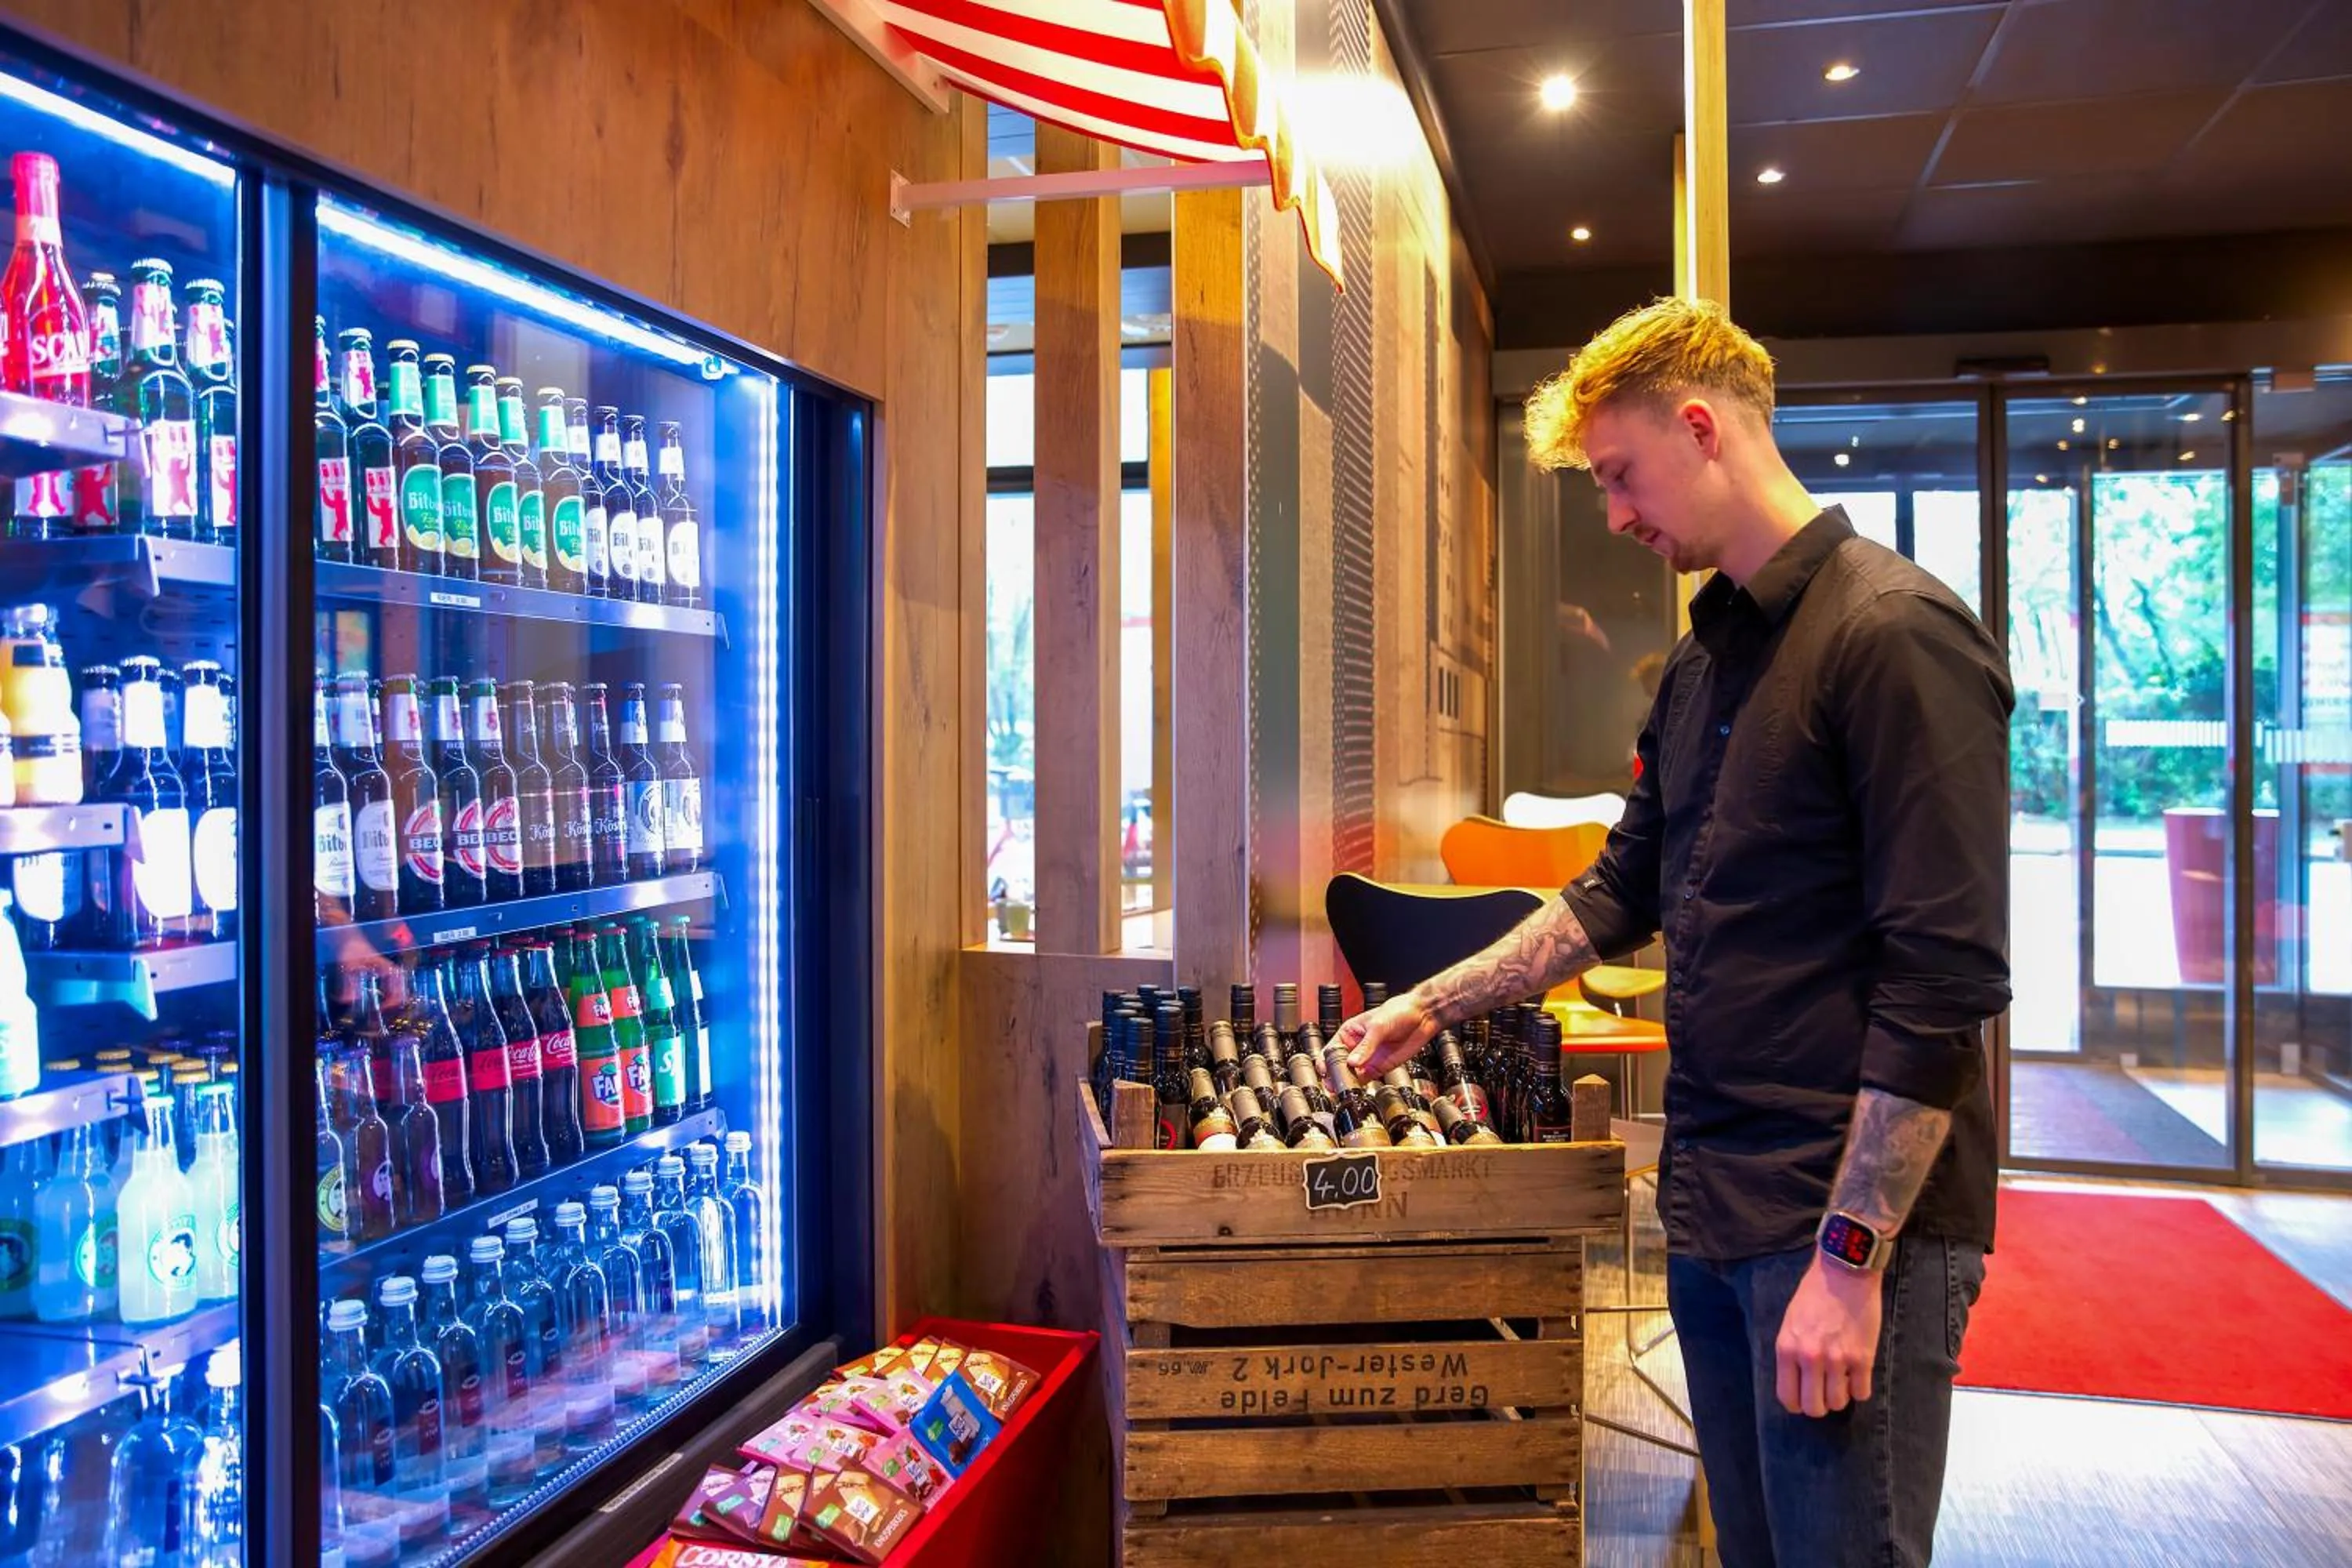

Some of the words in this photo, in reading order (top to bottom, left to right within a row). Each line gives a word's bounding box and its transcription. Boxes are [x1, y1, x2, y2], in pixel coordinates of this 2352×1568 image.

[1232, 1357, 1248, 1381] 2
[1265, 1352, 1468, 1380] Wester-Jork
[1221, 1388, 1308, 1414] Felde
[1329, 1387, 1396, 1406] zum
[1415, 1385, 1489, 1407] Gerd
